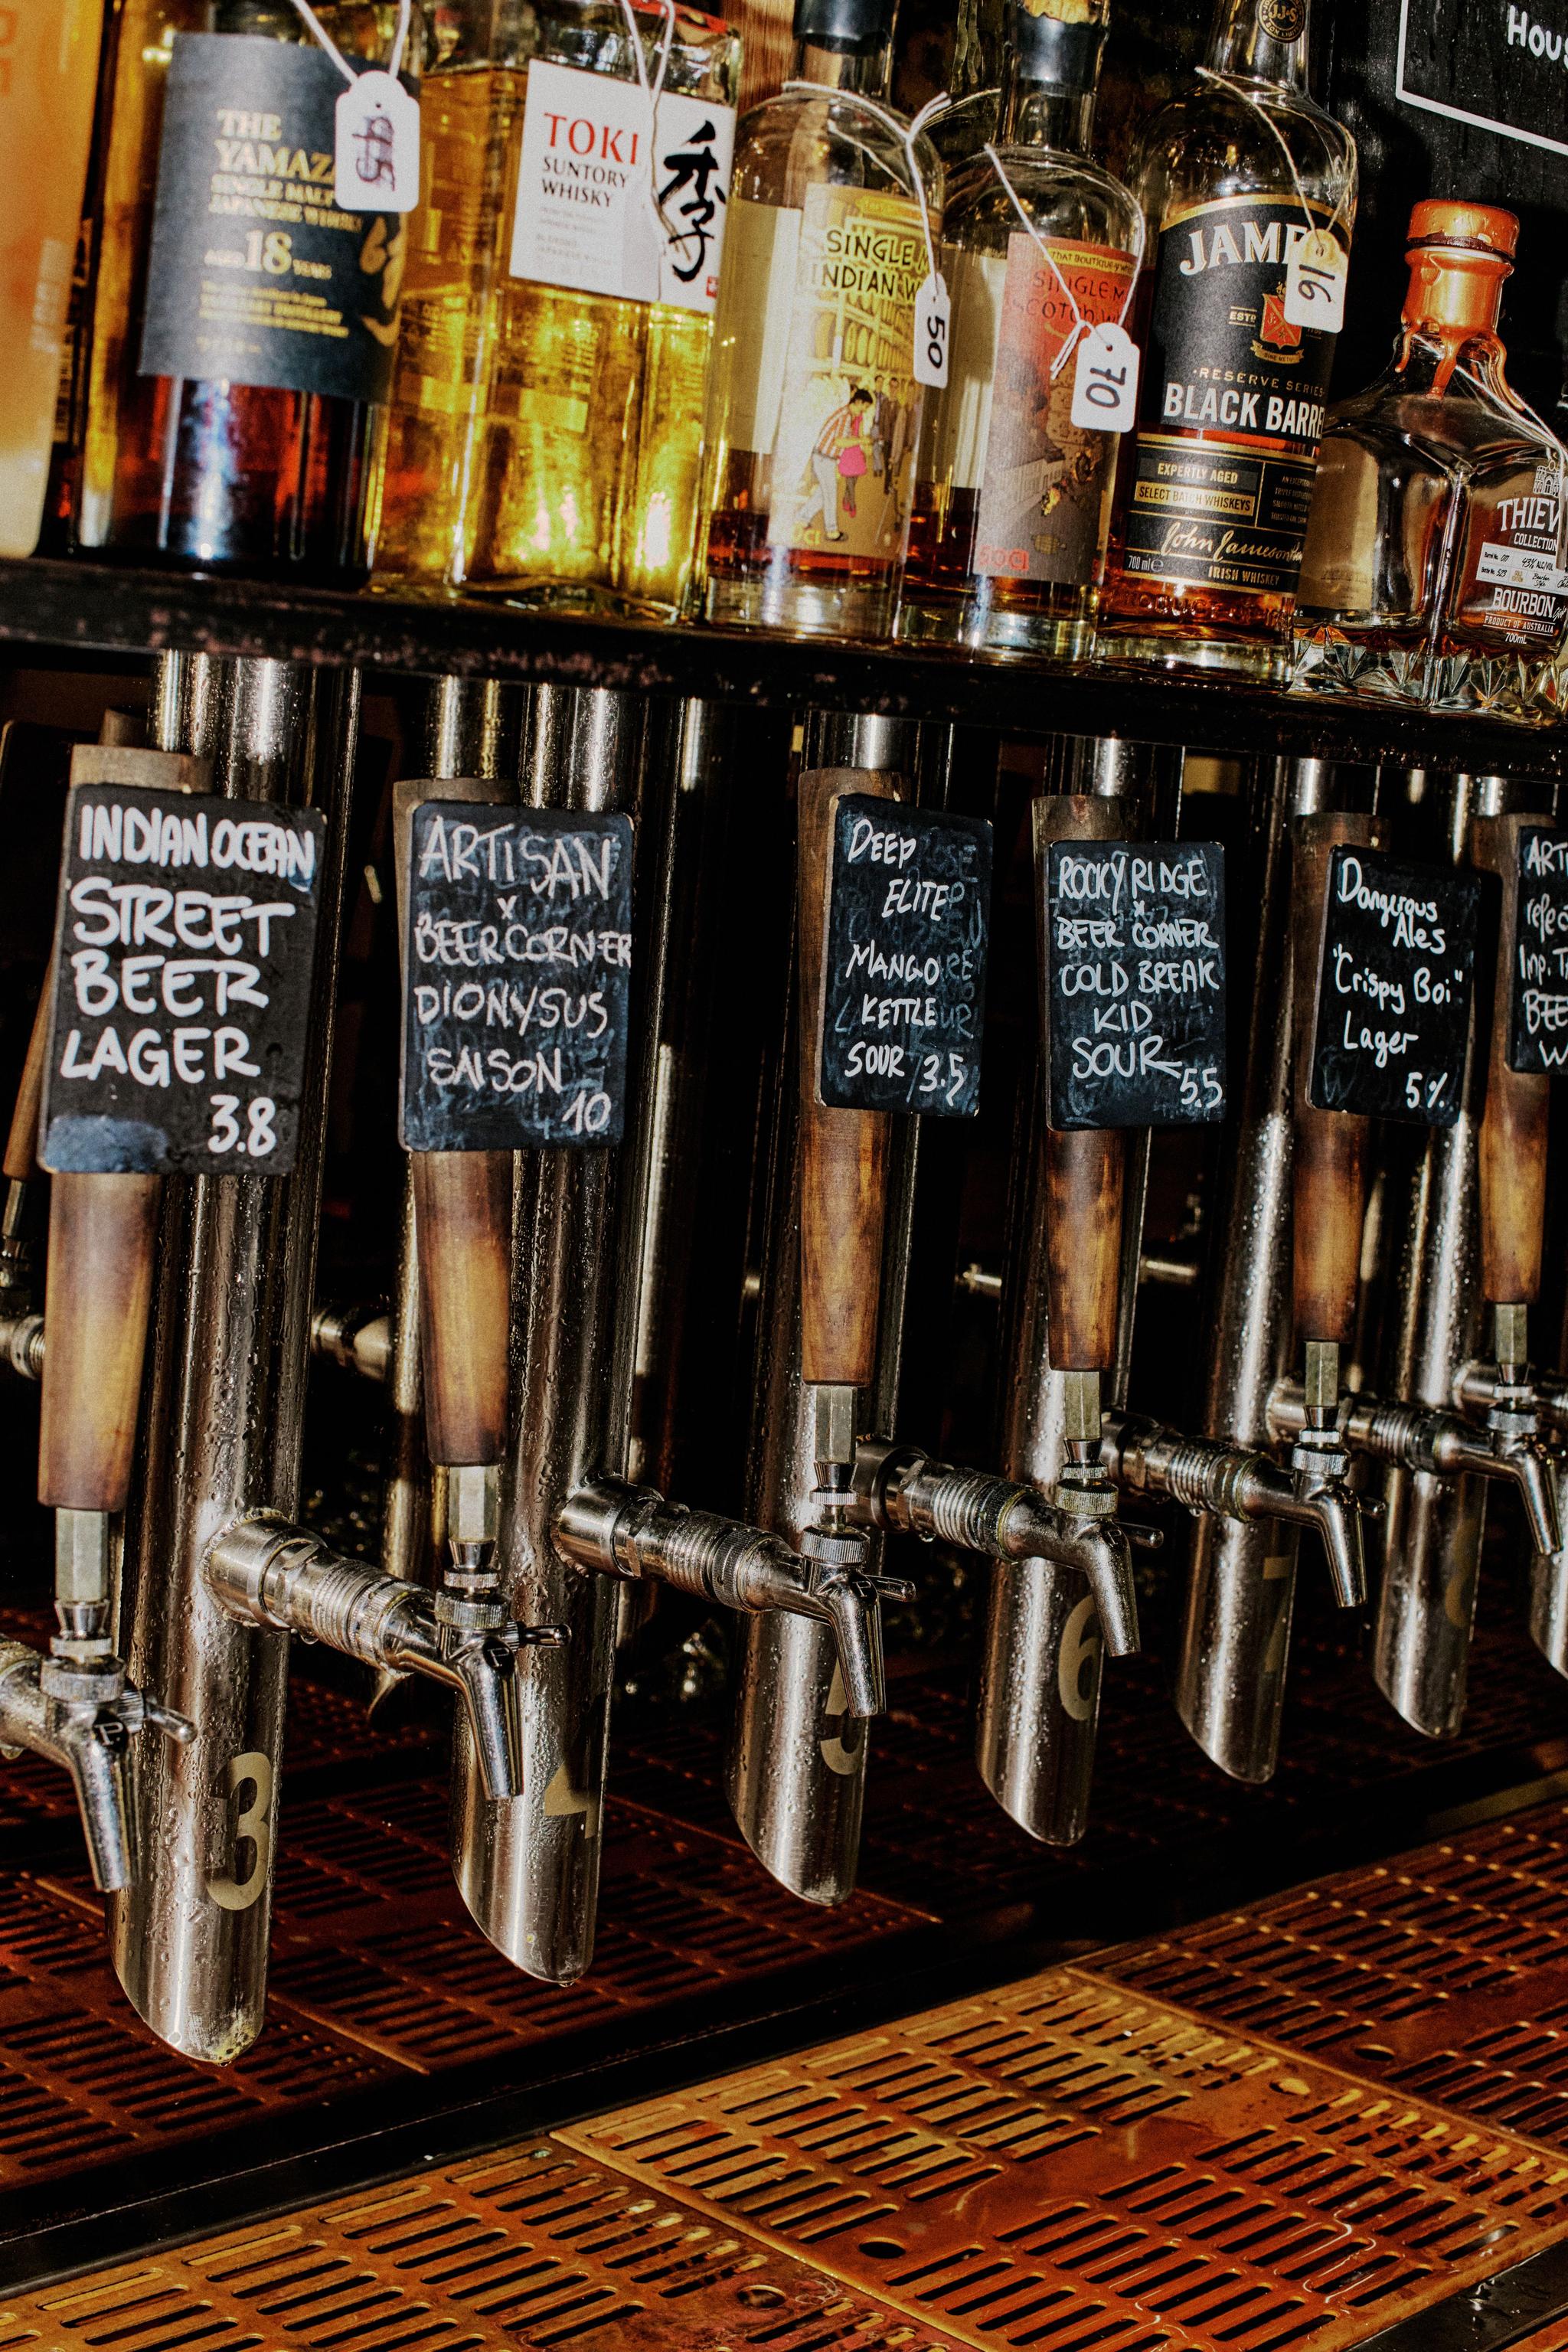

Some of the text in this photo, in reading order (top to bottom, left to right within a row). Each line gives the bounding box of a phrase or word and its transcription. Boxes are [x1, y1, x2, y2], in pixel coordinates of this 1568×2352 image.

[217, 109, 282, 142] THE
[543, 113, 639, 165] TOKI
[540, 178, 613, 207] WHISKY
[541, 155, 629, 189] SUNTORY
[658, 119, 727, 283] 季
[244, 230, 292, 275] 18
[826, 229, 913, 266] SINGLE
[812, 265, 895, 297] INDIAN
[1298, 263, 1336, 304] 16
[926, 315, 945, 369] 50
[1086, 366, 1127, 409] 70
[1200, 368, 1324, 397] RESERVE SERIES
[1164, 383, 1261, 430] BLACK
[1158, 462, 1238, 485] EXPERTLY AGED
[1139, 485, 1251, 512] SELECT BATCH WHISKEYS
[1160, 521, 1214, 557] John
[1129, 555, 1142, 571] 700
[1208, 565, 1280, 586] IRISH WHISKEY
[1484, 615, 1511, 628] PRODUCT
[1522, 622, 1553, 634] AUSTRALIA
[1492, 587, 1556, 619] BOURBON
[1504, 632, 1527, 645] 700mL
[80, 804, 315, 880] INDIAN OCEAN
[418, 815, 611, 900] ARTISAN
[881, 878, 950, 922] ELITE
[1058, 855, 1208, 916] ROCKY RIDGE
[1337, 857, 1439, 928] Dangerous
[70, 877, 296, 958] STREET
[1057, 916, 1220, 950] BEER CORNER
[1392, 912, 1446, 955] Ales
[413, 912, 632, 969] BEER CORNER
[845, 939, 939, 985] MANGO
[70, 948, 270, 1018] BEER
[1061, 958, 1220, 997] COLD BREAK
[413, 981, 608, 1039] DIONYSUS
[861, 993, 937, 1029] KETTLE
[1093, 1000, 1153, 1034] KID
[60, 1026, 261, 1088] LAGER
[1072, 1034, 1183, 1080] SOUR
[1343, 1010, 1419, 1068] Lager
[426, 1046, 564, 1094] SAISON
[844, 1040, 965, 1107] SOUR 3.5
[1179, 1067, 1223, 1109] 5.5
[207, 1094, 276, 1157] 3.8
[561, 1090, 612, 1135] 10
[1057, 1592, 1104, 1721] 6
[204, 1751, 273, 1911] 3
